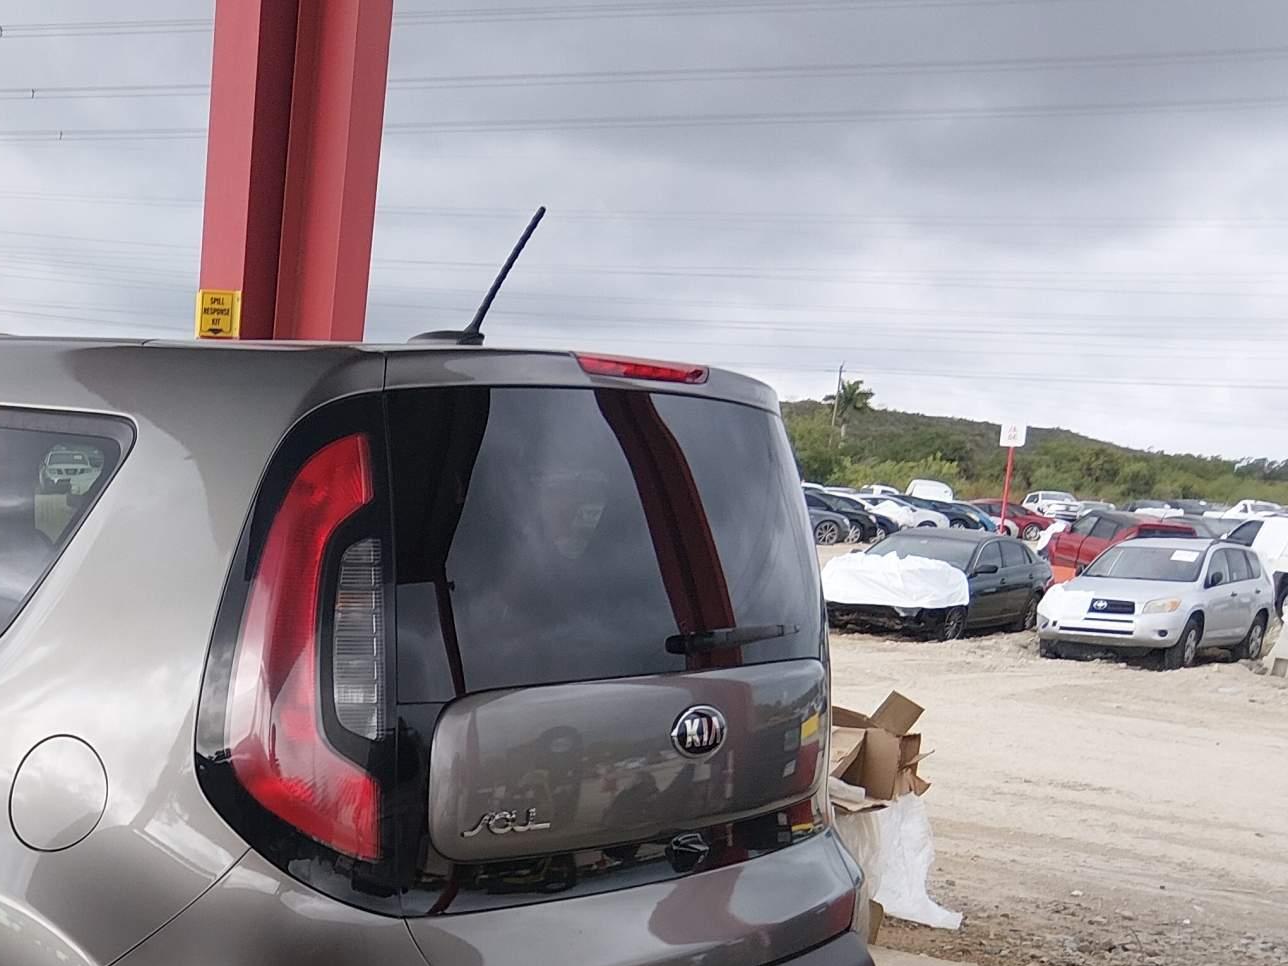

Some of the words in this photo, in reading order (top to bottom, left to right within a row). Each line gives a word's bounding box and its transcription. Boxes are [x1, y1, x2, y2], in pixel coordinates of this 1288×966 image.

[210, 296, 224, 305] SPILL
[203, 307, 230, 316] RESPONSE
[211, 318, 221, 326] KIT
[684, 716, 721, 748] KIA
[460, 807, 551, 838] SOUL
